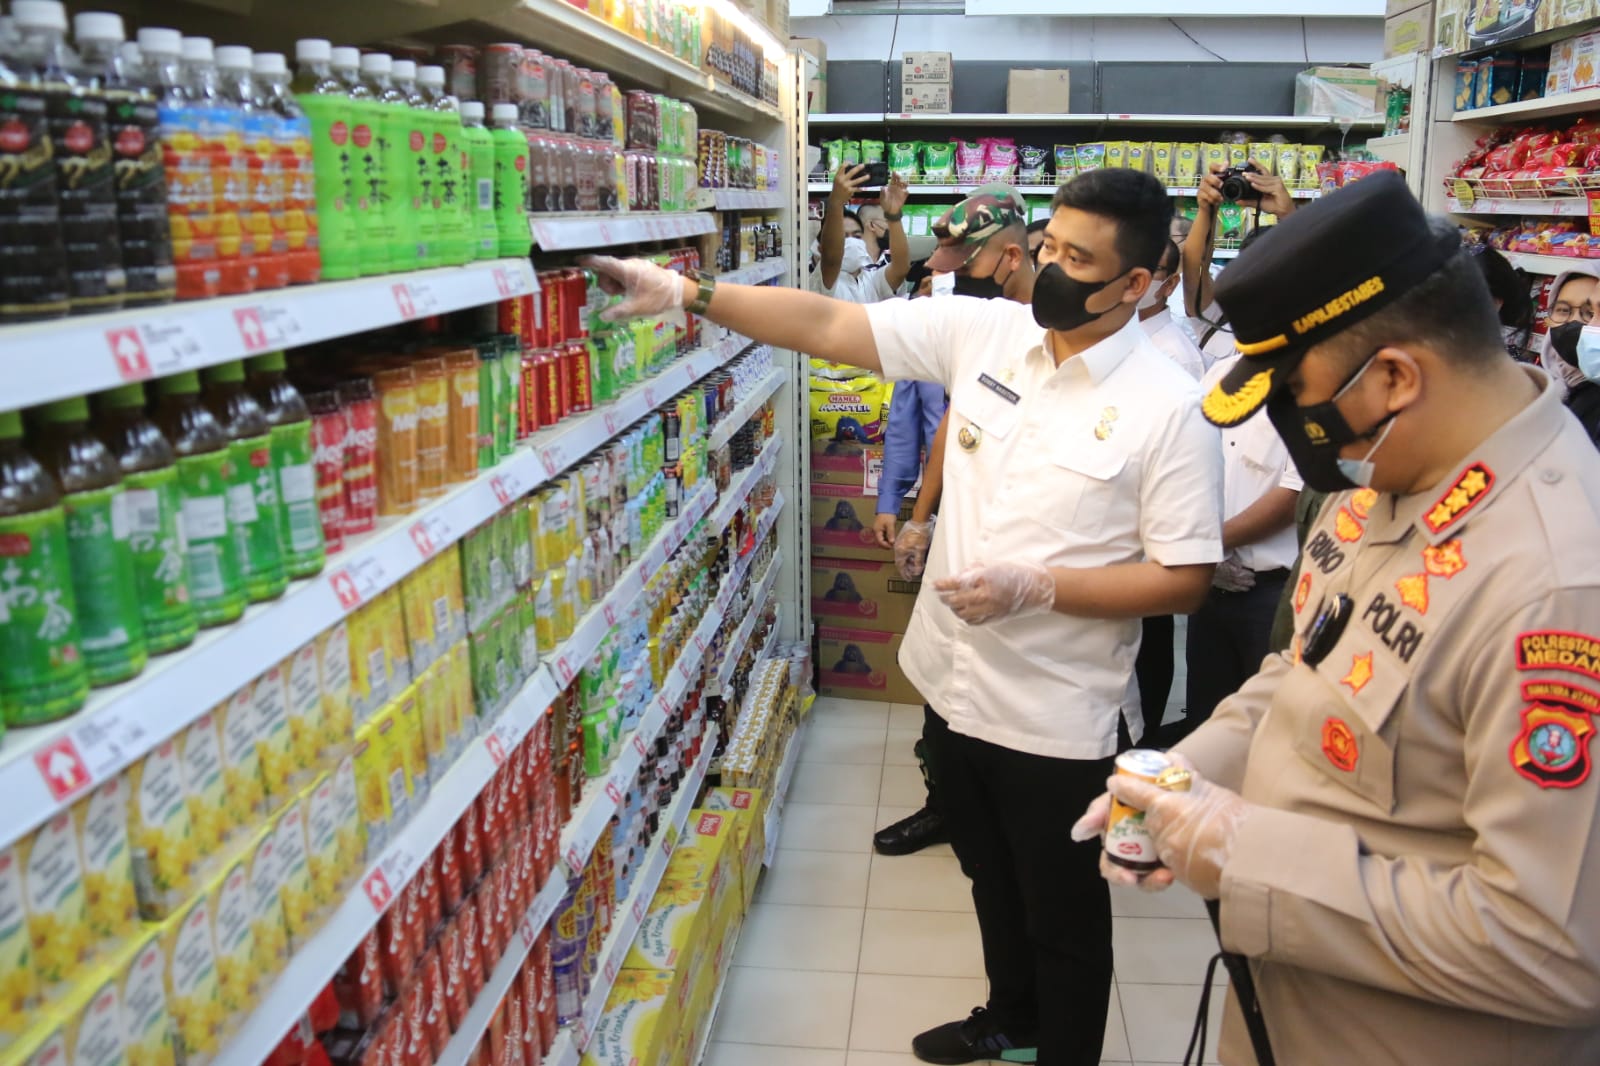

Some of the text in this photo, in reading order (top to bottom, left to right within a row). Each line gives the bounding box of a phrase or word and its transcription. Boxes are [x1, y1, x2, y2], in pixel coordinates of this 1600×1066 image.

[1292, 276, 1385, 334] KAPOLRESTABES
[1306, 529, 1345, 575] RIKO
[1362, 592, 1424, 663] POLRI
